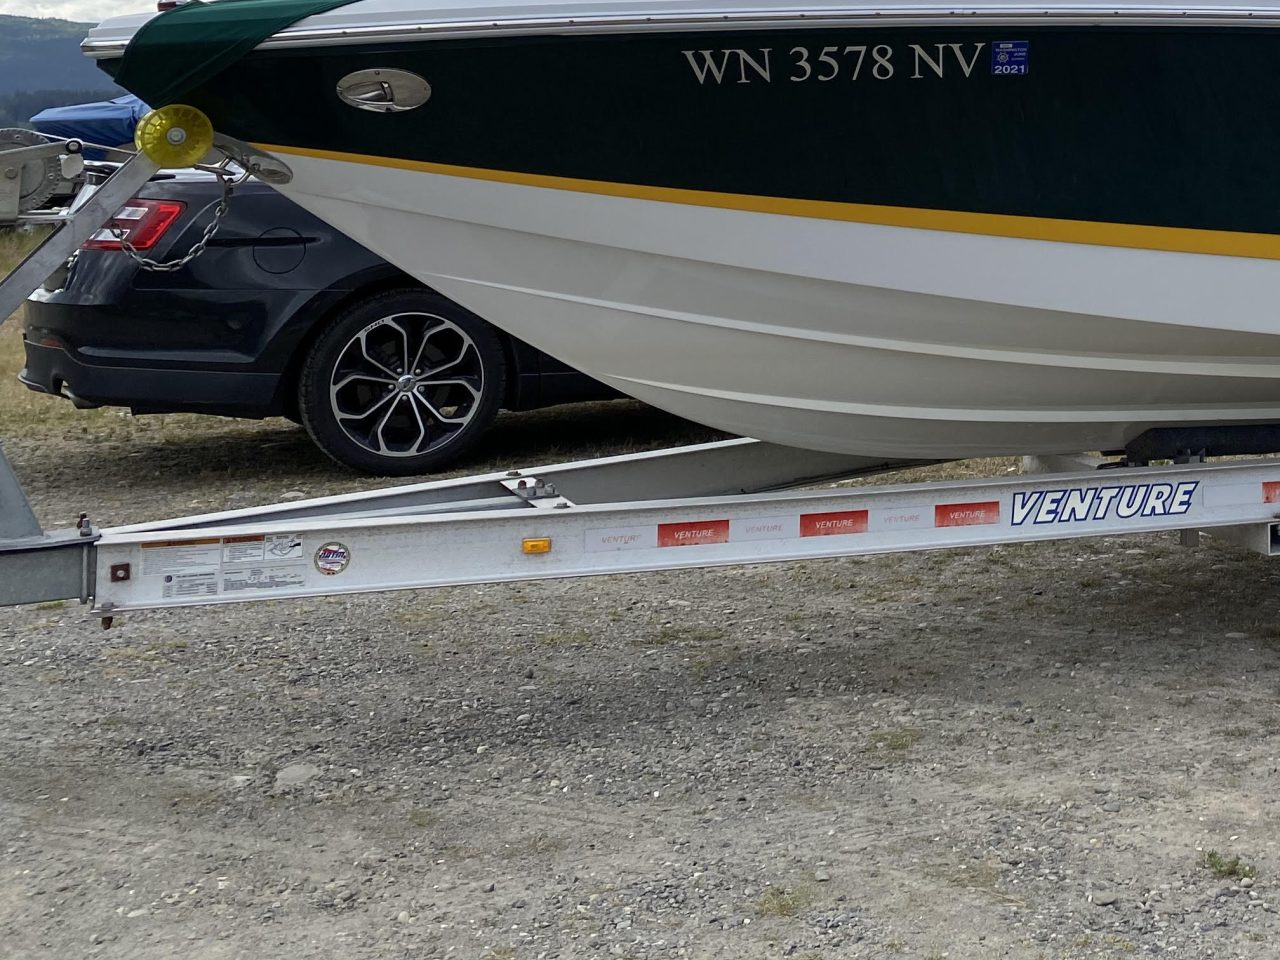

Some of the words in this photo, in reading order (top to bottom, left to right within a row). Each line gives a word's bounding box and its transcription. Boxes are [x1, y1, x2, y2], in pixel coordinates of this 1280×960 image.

[681, 48, 773, 85] WN
[789, 44, 895, 82] 3578
[908, 42, 986, 79] NV
[994, 64, 1025, 74] 2021
[1010, 480, 1201, 527] VENTURE
[950, 510, 986, 520] VENTURE
[745, 524, 783, 534] VENTURE
[815, 519, 855, 529] VENTURE
[674, 529, 715, 539] VENTURE
